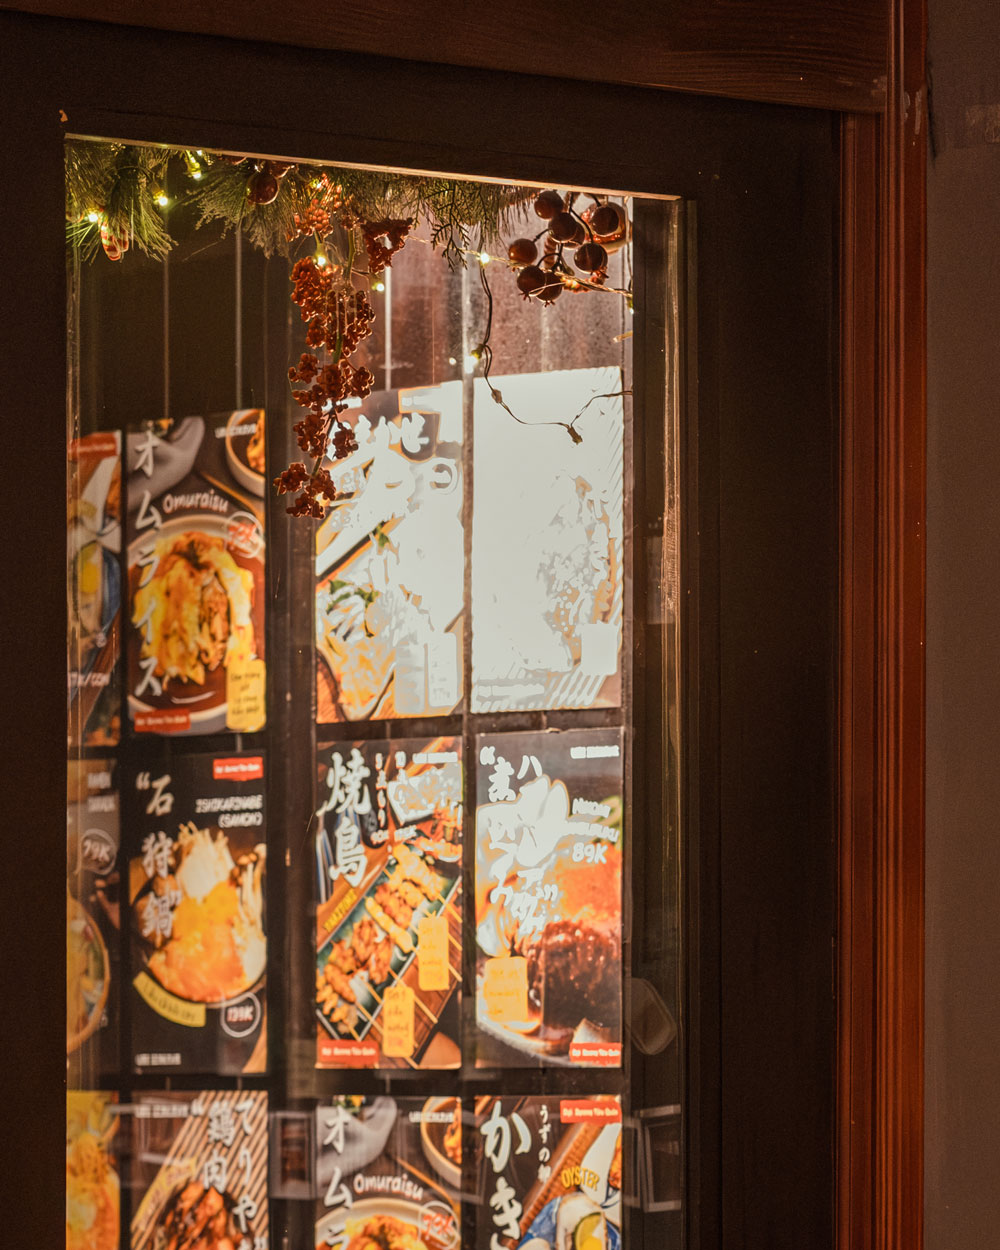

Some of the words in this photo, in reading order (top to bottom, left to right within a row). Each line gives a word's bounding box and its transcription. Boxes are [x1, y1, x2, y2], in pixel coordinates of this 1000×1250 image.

[163, 488, 229, 514] Omuraisu
[572, 842, 609, 864] 89K
[354, 1173, 425, 1200] Omuraisu
[561, 1166, 600, 1191] OYSTER
